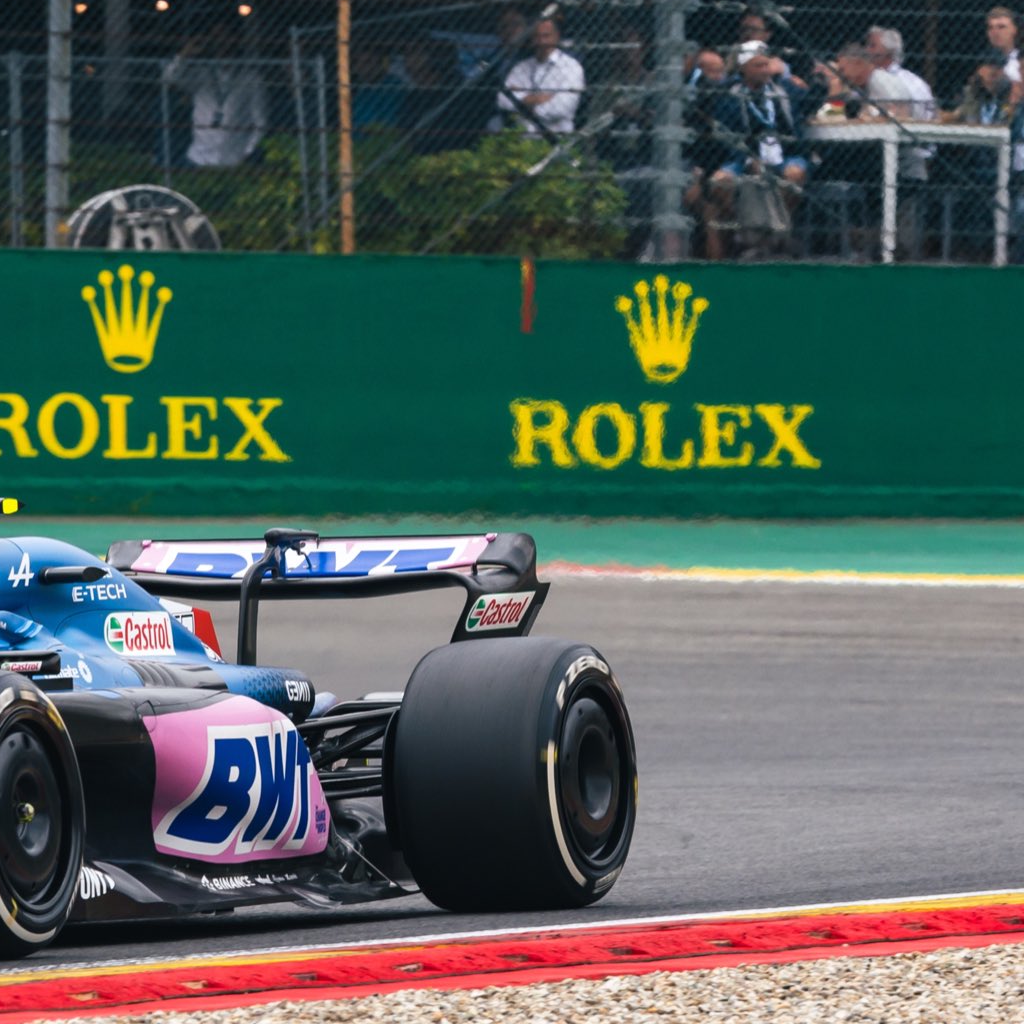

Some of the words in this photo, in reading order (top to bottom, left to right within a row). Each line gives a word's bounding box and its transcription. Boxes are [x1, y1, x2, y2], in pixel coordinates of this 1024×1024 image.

[511, 401, 821, 469] ROLEX
[71, 583, 127, 603] E-TECH
[478, 596, 529, 626] Castrol
[125, 617, 171, 651] Castrol
[162, 727, 312, 848] BWT
